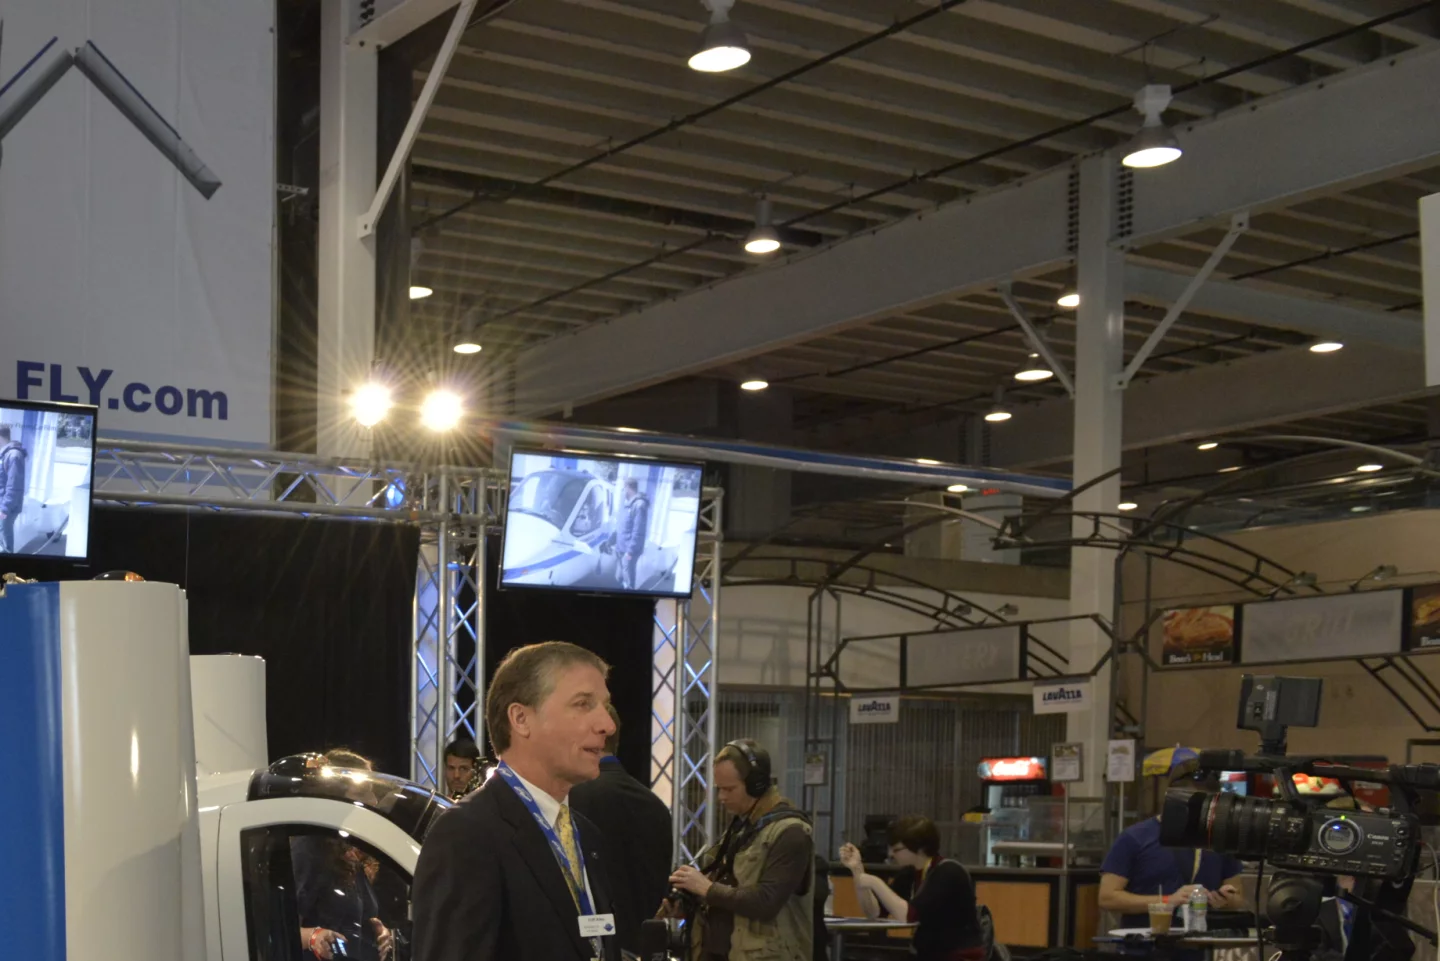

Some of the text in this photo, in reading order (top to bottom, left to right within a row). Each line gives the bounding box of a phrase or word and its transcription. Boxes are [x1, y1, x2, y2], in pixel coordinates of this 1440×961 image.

[16, 360, 229, 420] FLY.com
[1042, 687, 1083, 702] LAVAZZA
[858, 700, 891, 712] LAVAZZA
